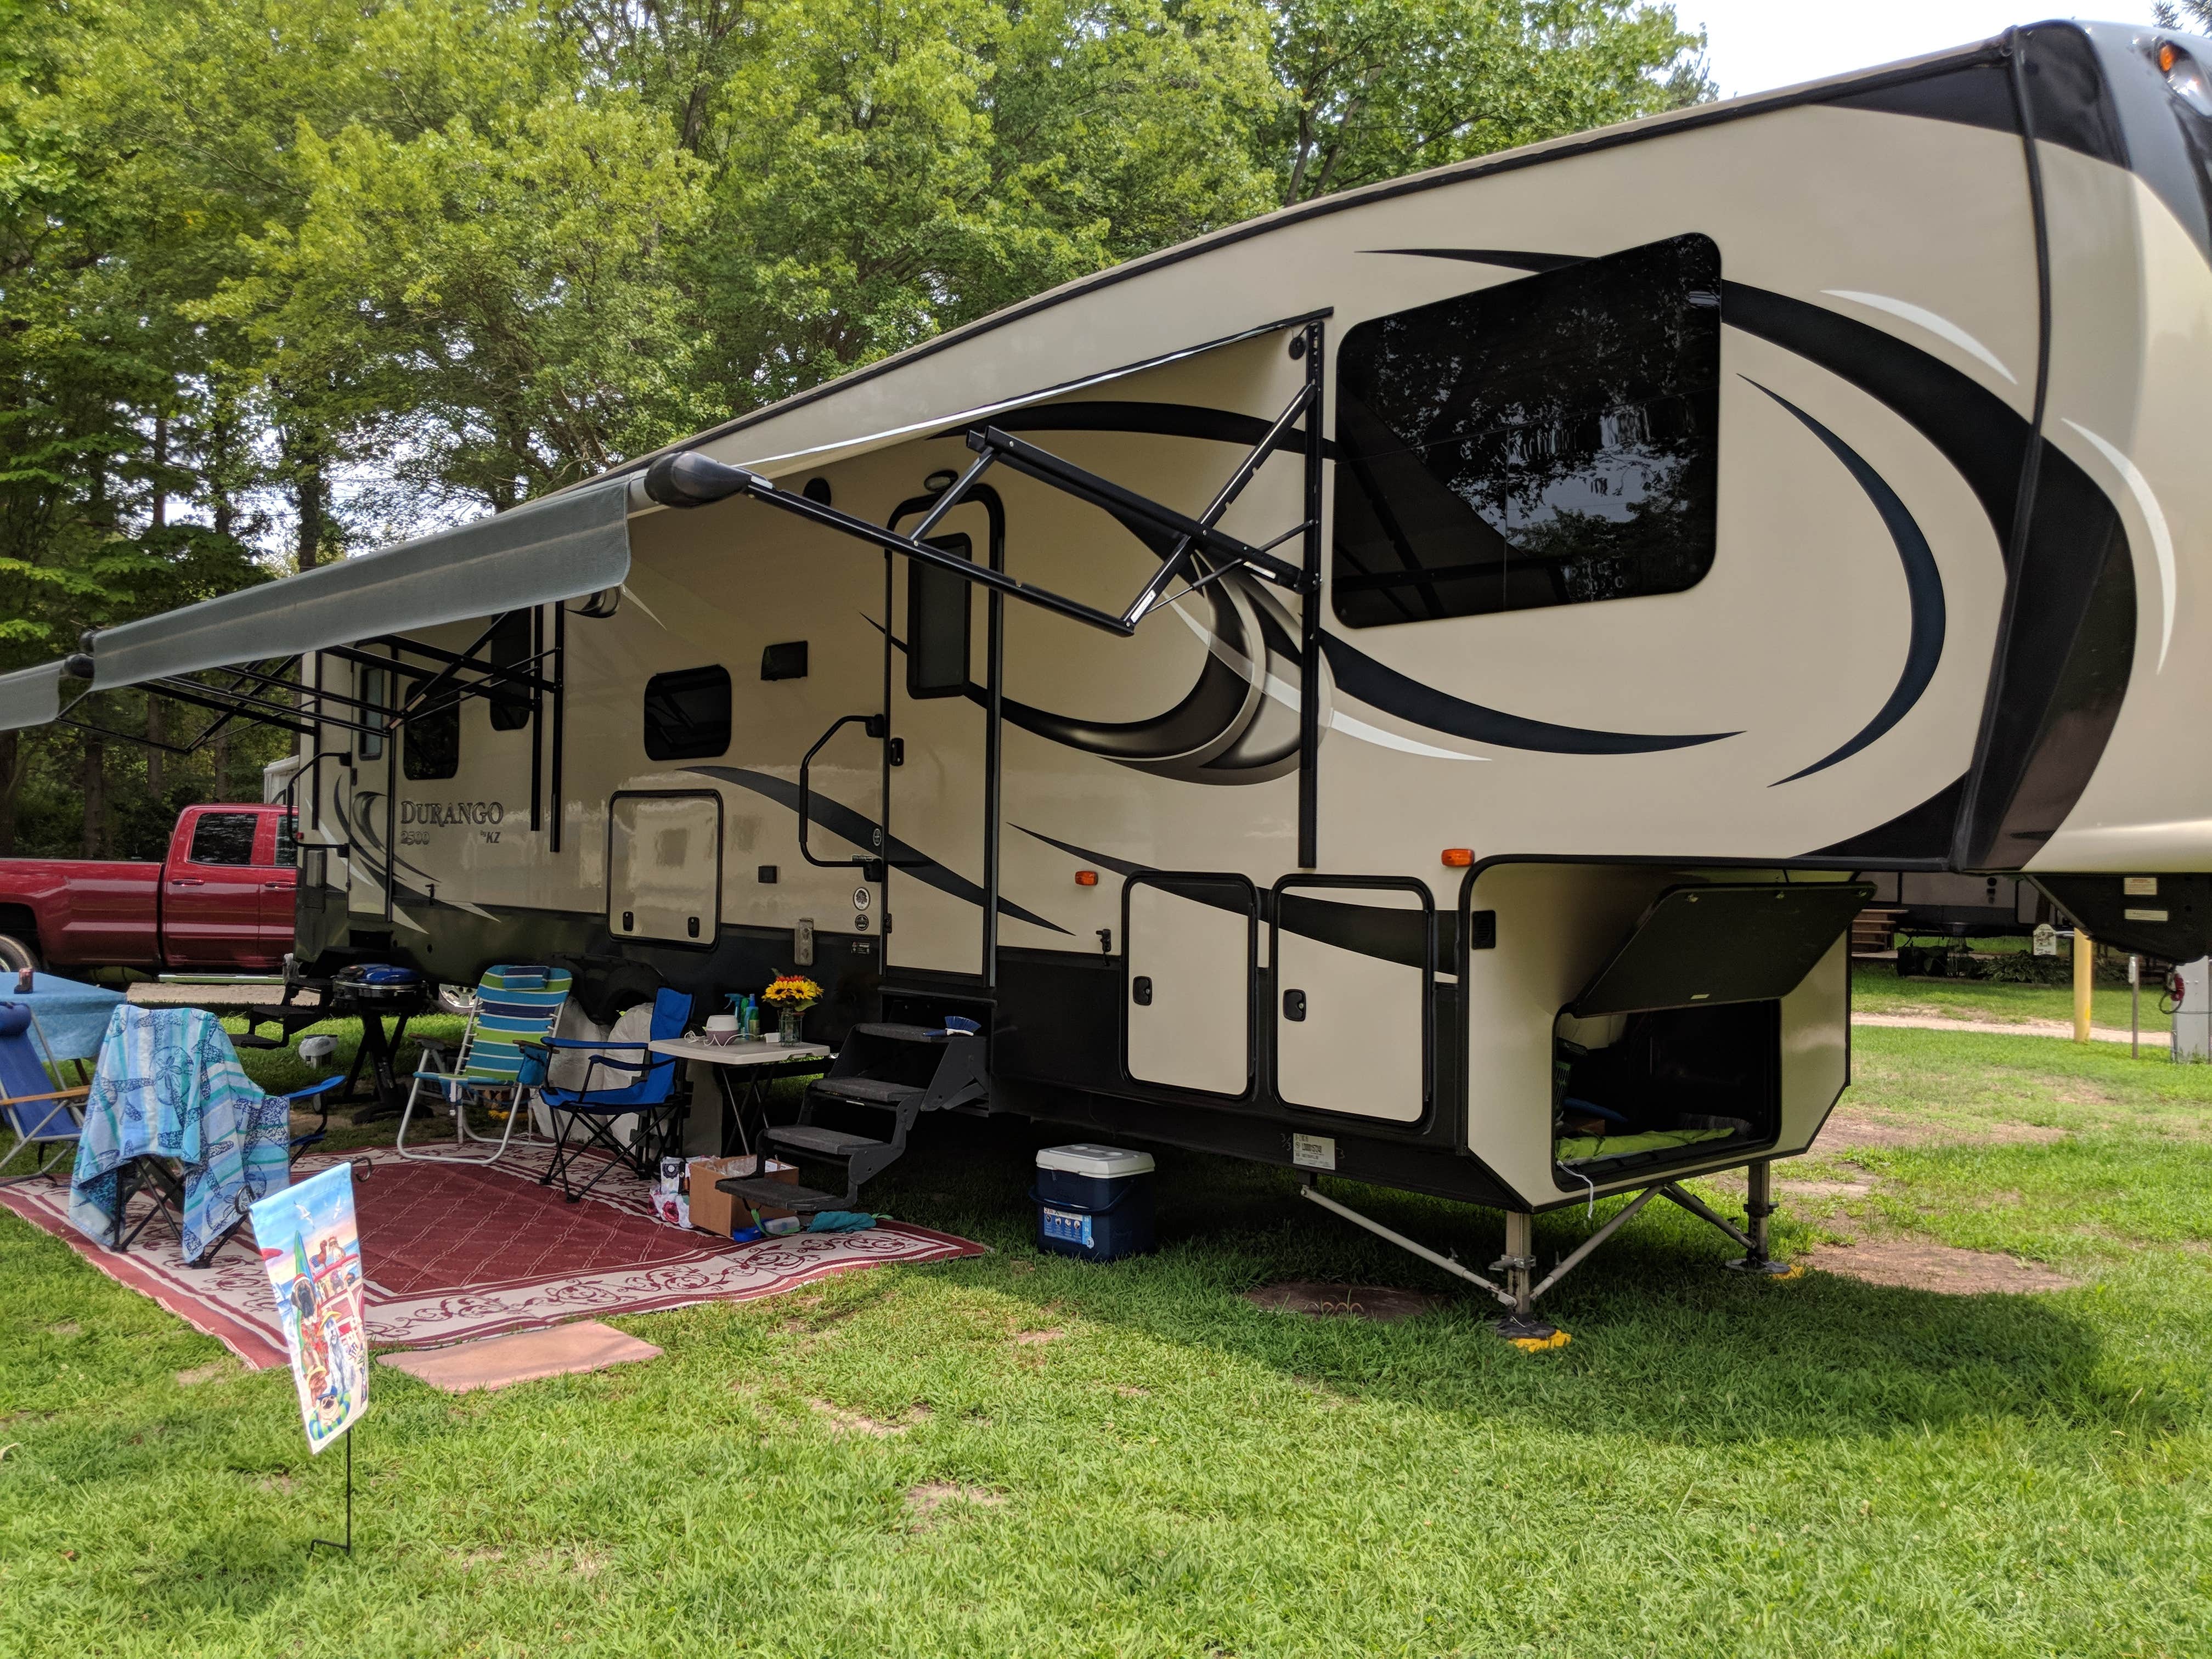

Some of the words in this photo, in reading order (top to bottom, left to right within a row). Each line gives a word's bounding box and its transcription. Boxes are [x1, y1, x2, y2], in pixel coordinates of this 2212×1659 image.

[400, 800, 504, 827] DURANGO
[400, 831, 430, 845] 2500
[486, 832, 501, 843] KZ
